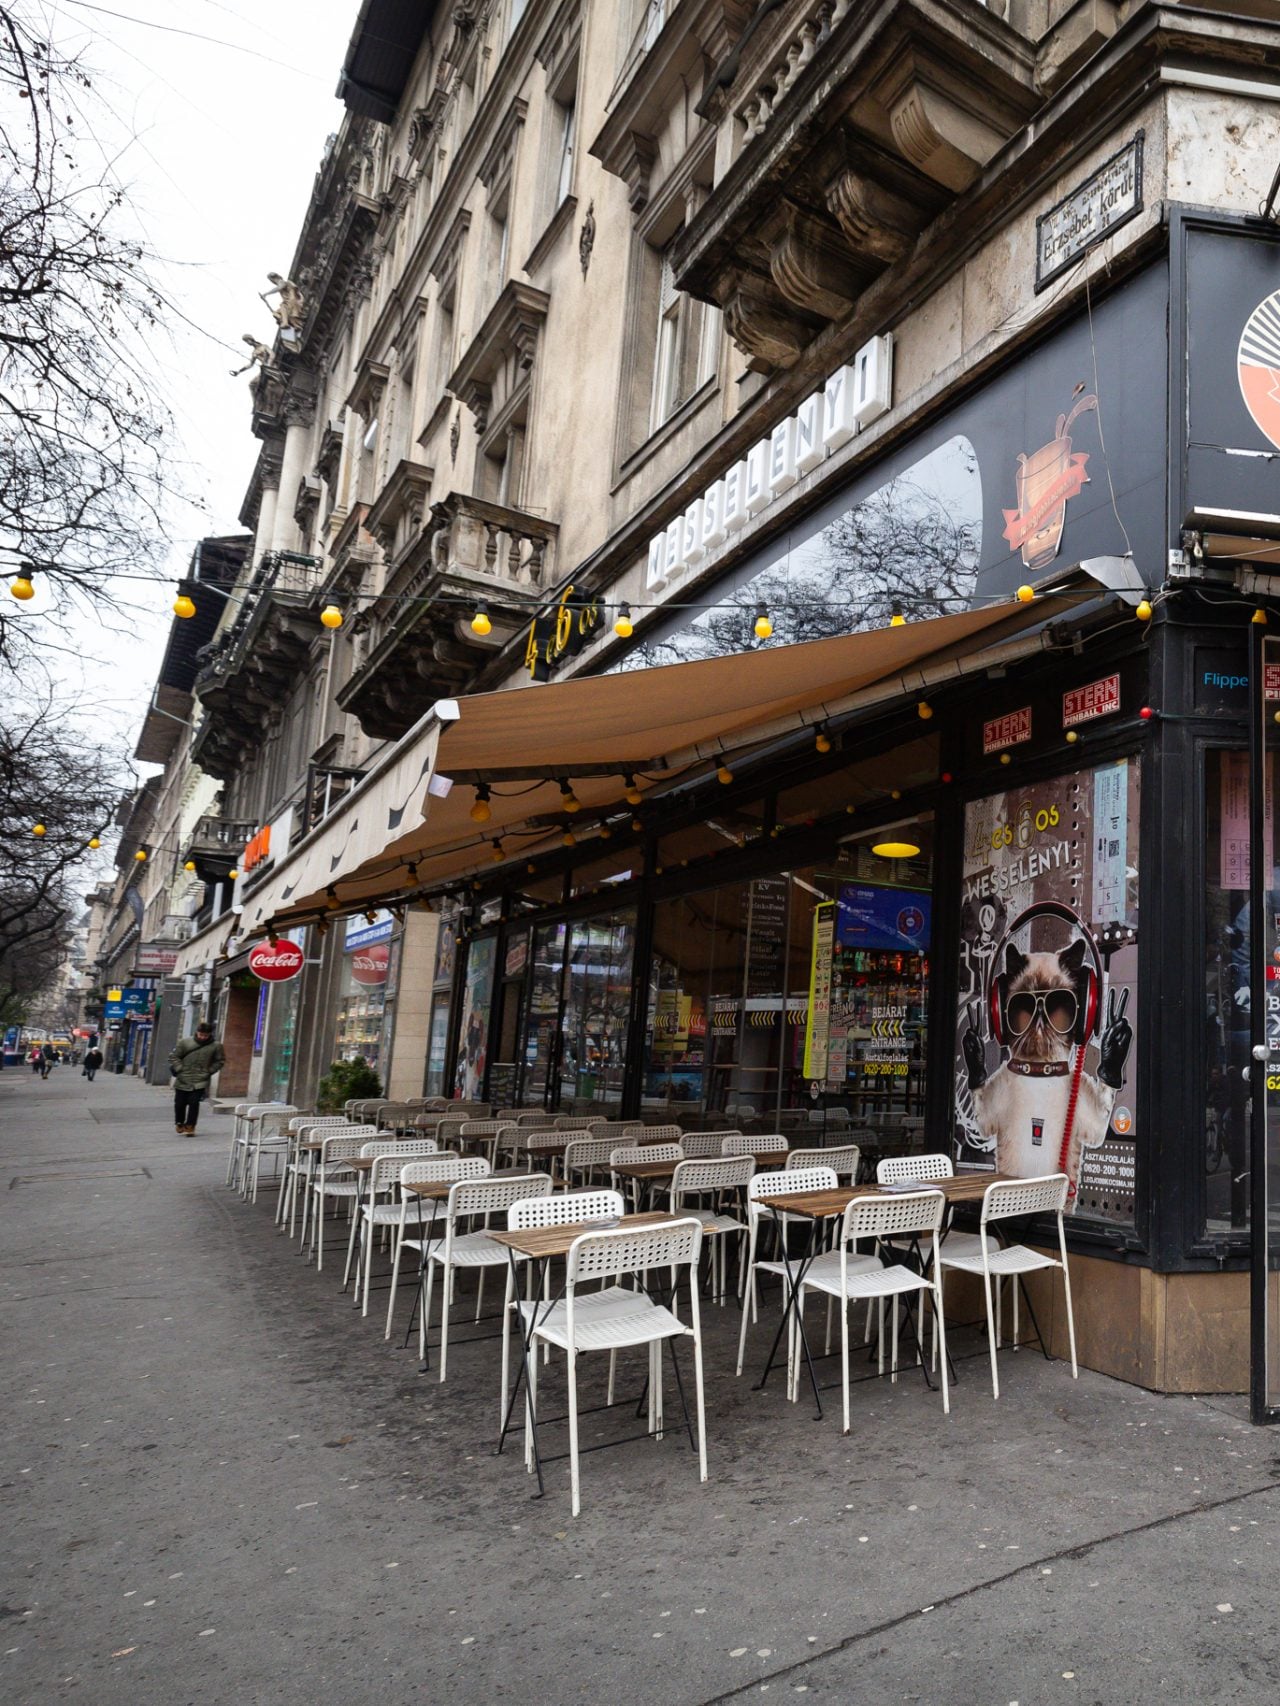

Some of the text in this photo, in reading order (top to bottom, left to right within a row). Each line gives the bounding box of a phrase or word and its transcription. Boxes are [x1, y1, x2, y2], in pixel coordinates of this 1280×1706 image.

[1044, 172, 1134, 262] Erzsébet körút
[1203, 671, 1249, 689] Flippe
[1064, 676, 1119, 716] STERN
[984, 710, 1032, 745] STERN
[966, 840, 1071, 902] WESSELÉNYI
[251, 952, 302, 968] Coca-Cola
[871, 1004, 908, 1019] BEJÁRAT
[870, 1037, 907, 1048] ENTRANCE
[1084, 1152, 1136, 1165] ASZTALFOGLALÁS
[1083, 1163, 1135, 1178] 0620-200-1000
